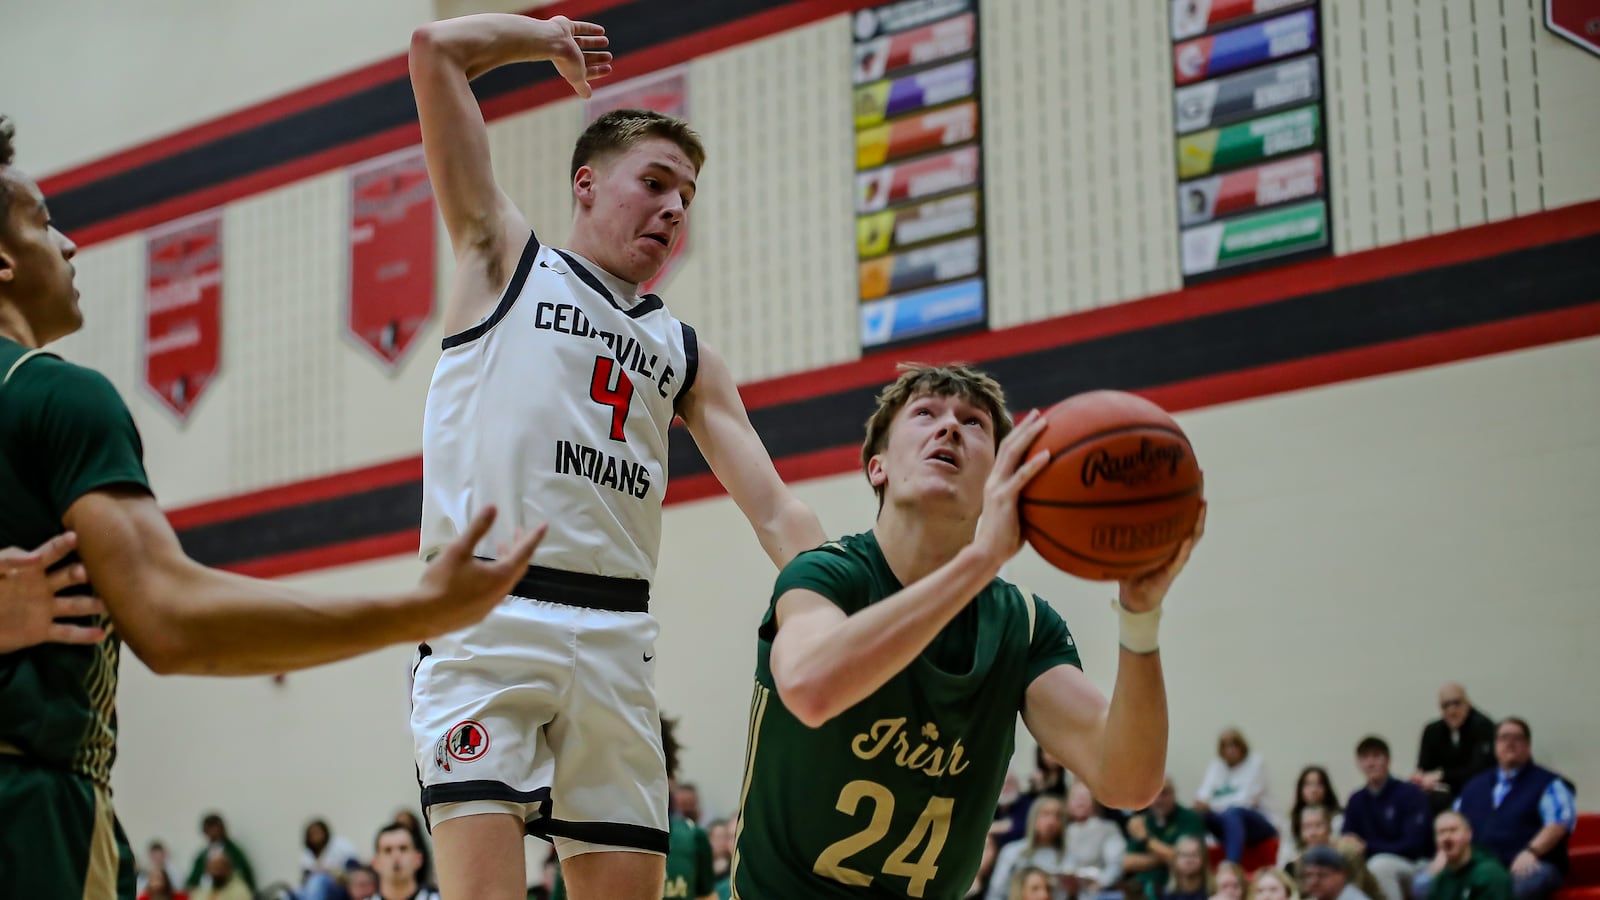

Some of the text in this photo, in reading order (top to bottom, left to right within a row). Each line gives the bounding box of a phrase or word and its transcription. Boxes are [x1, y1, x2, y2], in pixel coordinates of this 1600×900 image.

[589, 355, 635, 443] 4
[555, 440, 650, 500] INDIANS
[1081, 435, 1184, 489] Rawlings
[851, 716, 970, 778] Irish
[812, 779, 955, 898] 24
